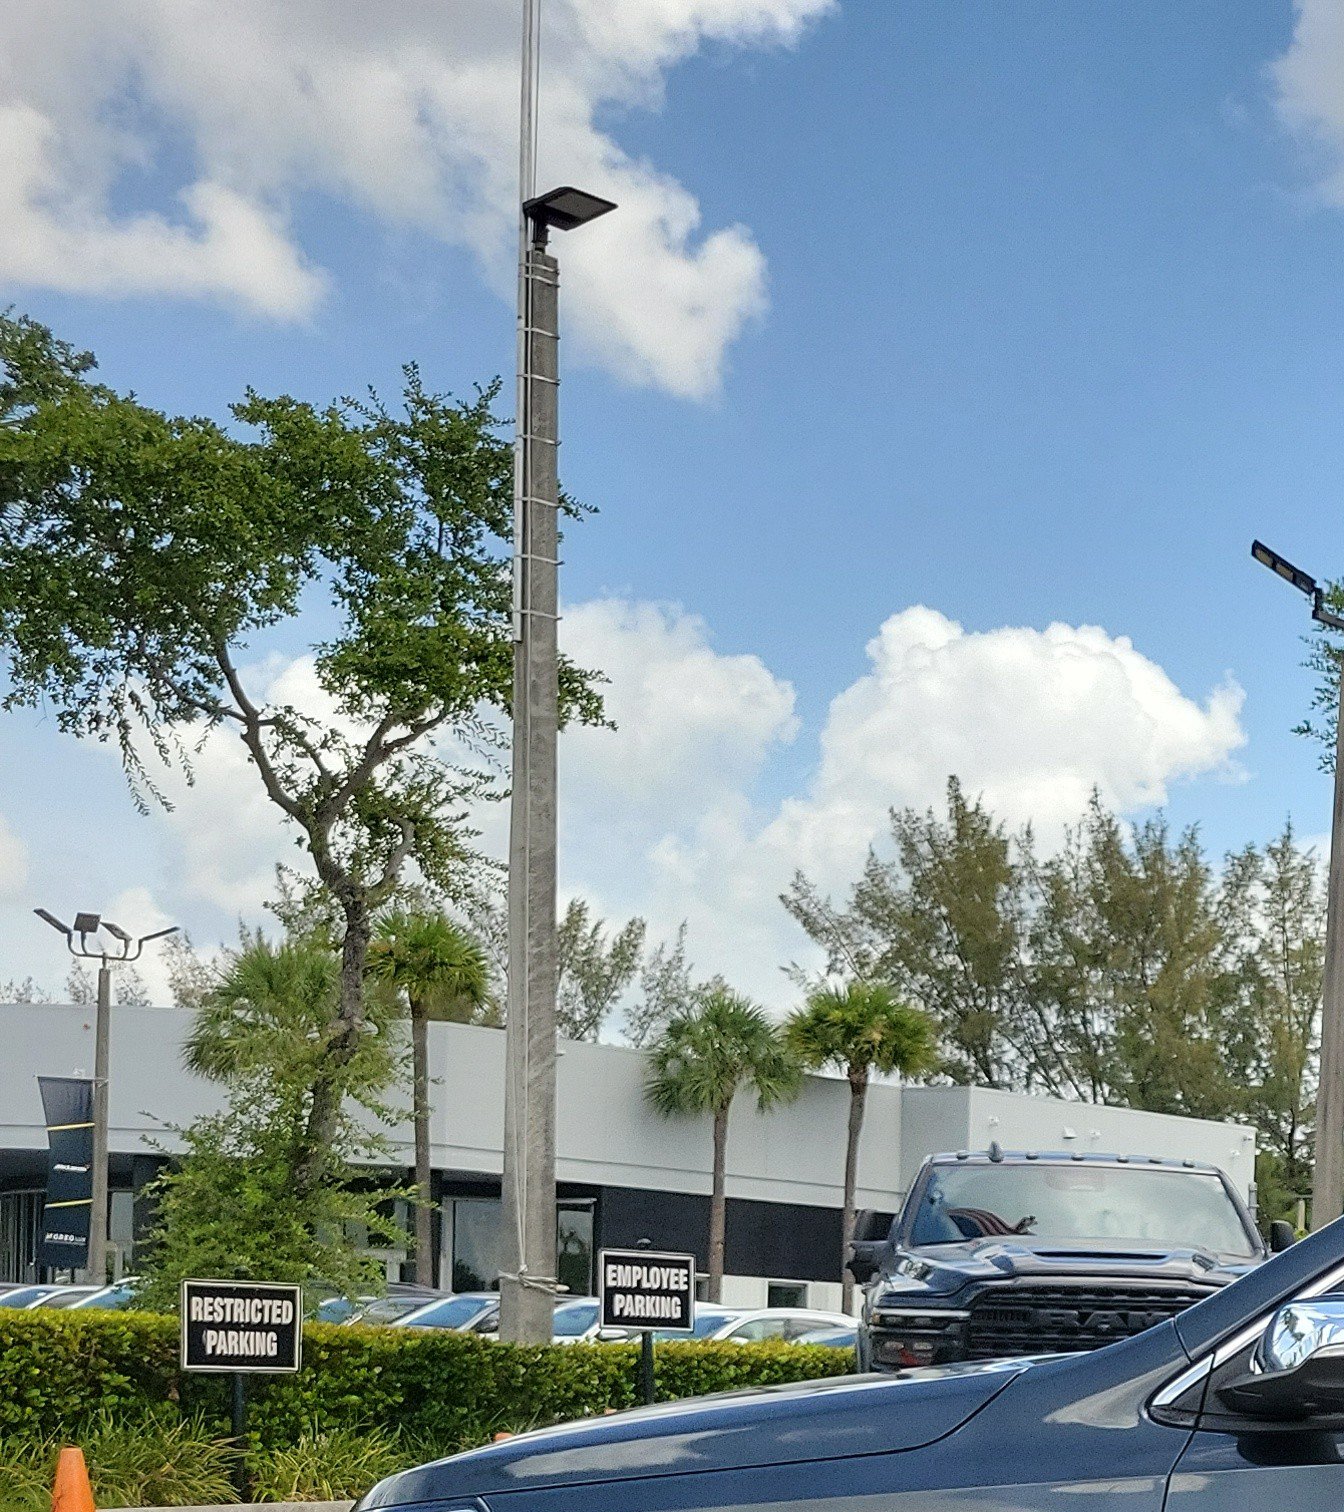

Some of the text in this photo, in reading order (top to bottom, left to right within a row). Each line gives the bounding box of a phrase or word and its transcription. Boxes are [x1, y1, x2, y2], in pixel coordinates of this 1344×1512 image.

[606, 1263, 689, 1291] EMPLOYEE
[190, 1296, 294, 1325] RESTRICTED
[613, 1293, 682, 1319] PARKING
[205, 1329, 278, 1357] PARKING
